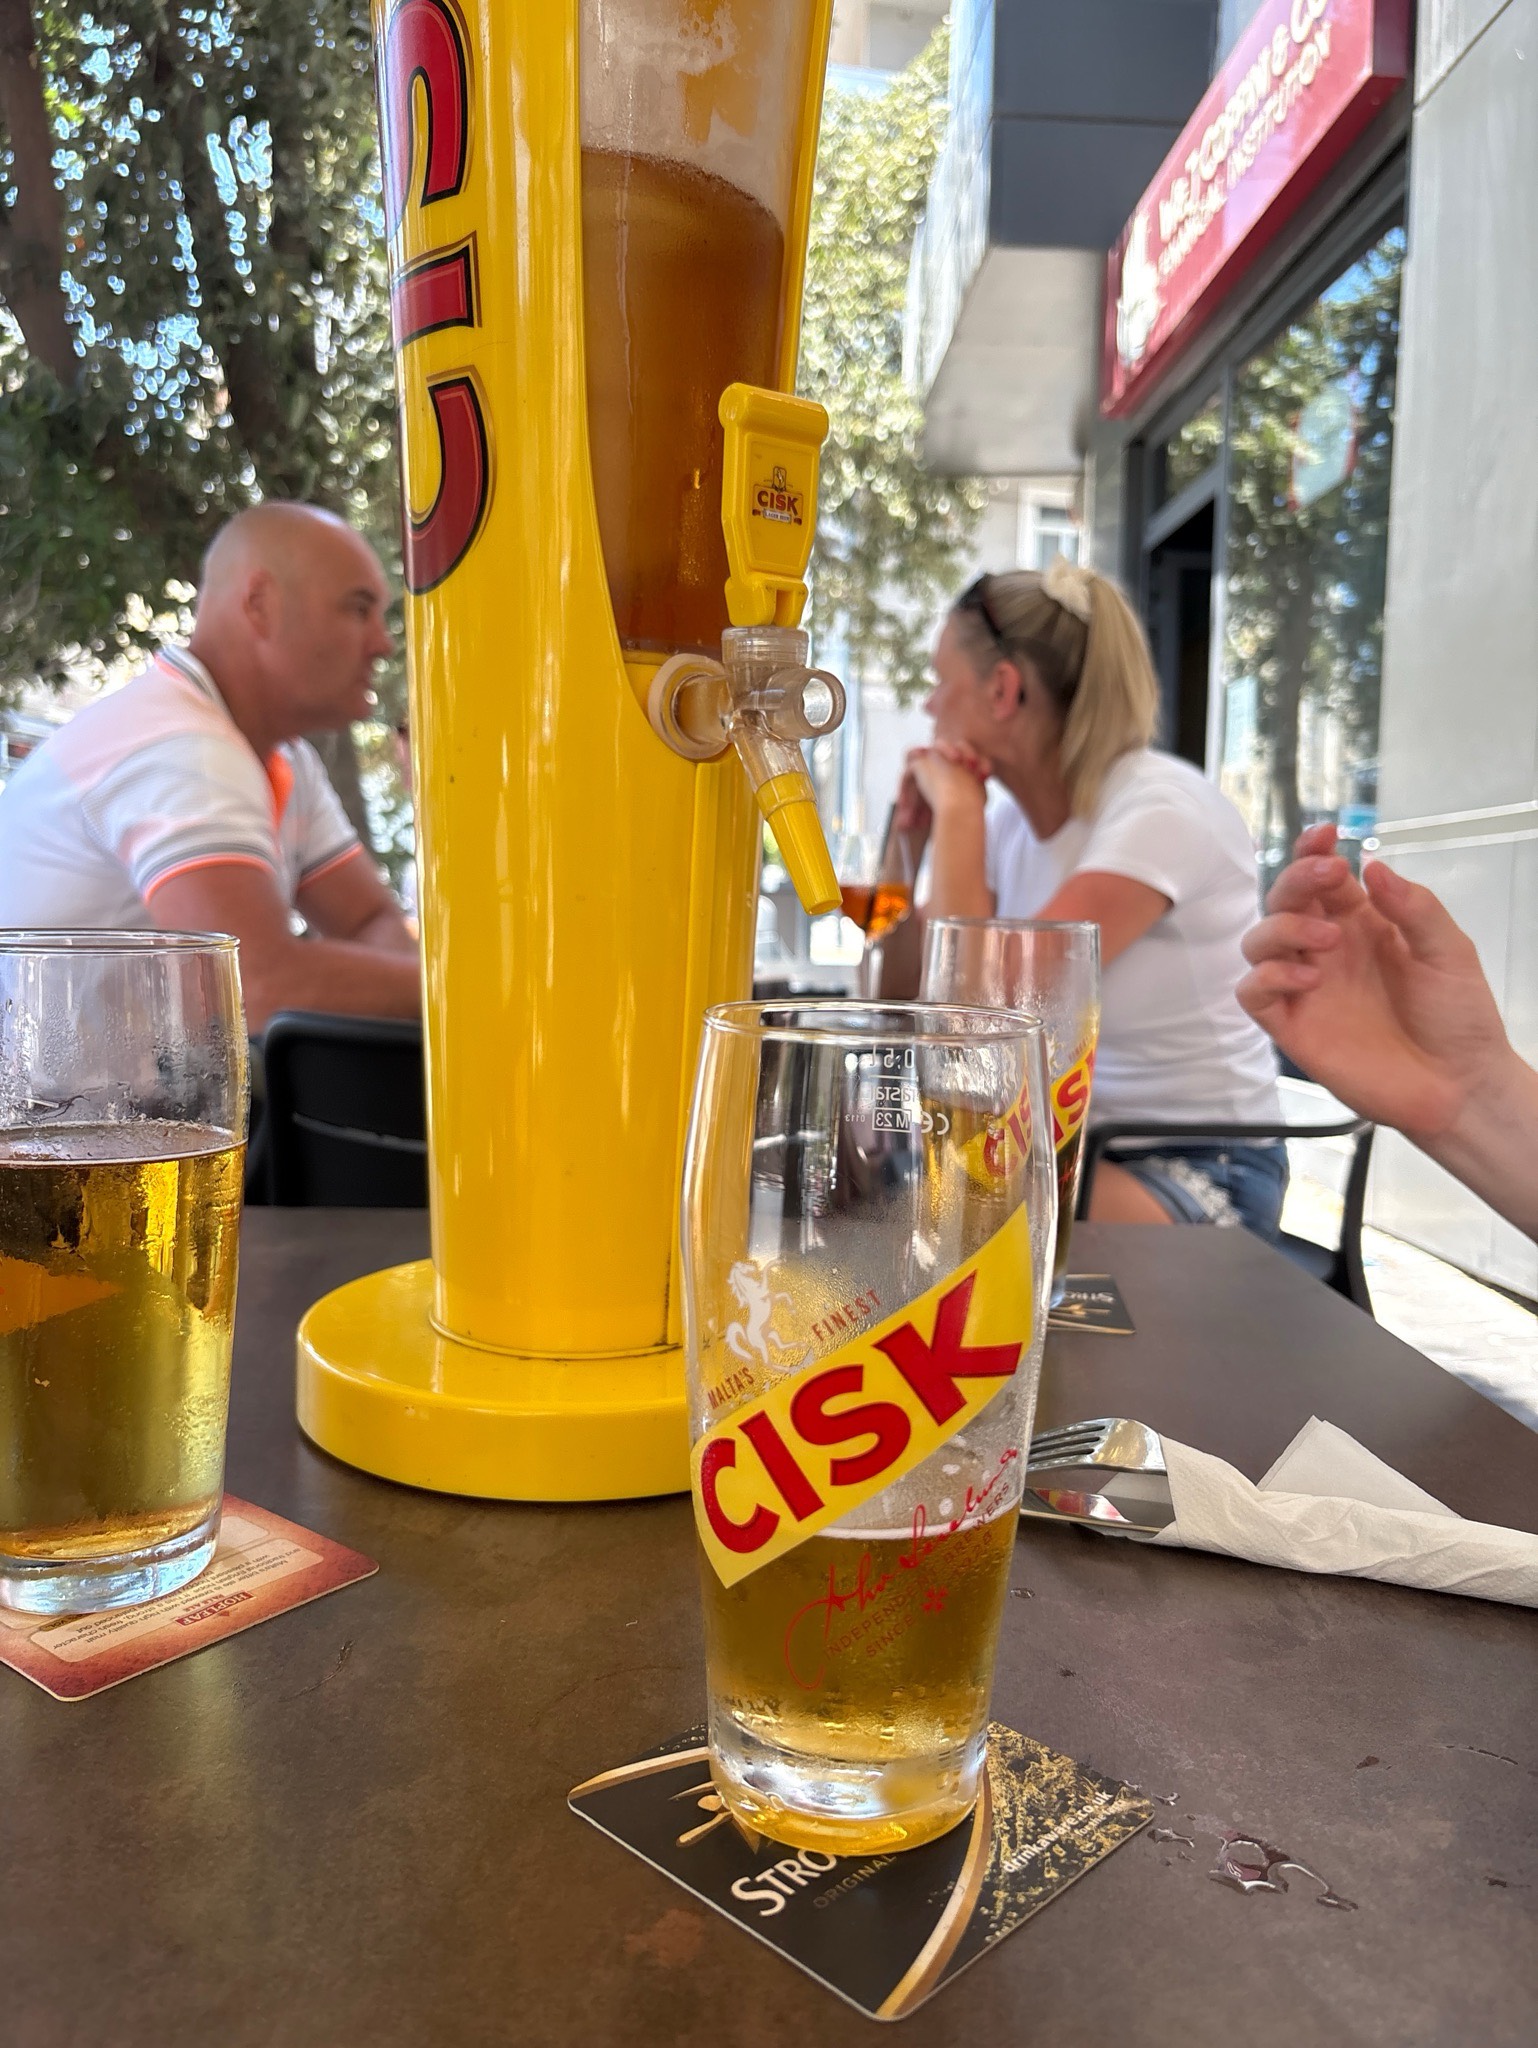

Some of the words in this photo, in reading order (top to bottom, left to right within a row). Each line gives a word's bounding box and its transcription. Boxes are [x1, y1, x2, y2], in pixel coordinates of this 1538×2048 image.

[757, 490, 798, 516] CISK
[707, 1366, 755, 1410] MALTA'S
[811, 1288, 882, 1342] FINEST
[700, 1268, 1023, 1554] CISK
[942, 1482, 1010, 1566] BREWERS
[181, 1591, 251, 1626] HOPLEAF
[866, 1614, 915, 1657] SINCE
[1002, 1790, 1114, 1874] drinkaware.co.uk
[813, 1852, 897, 1910] ORIGINAL
